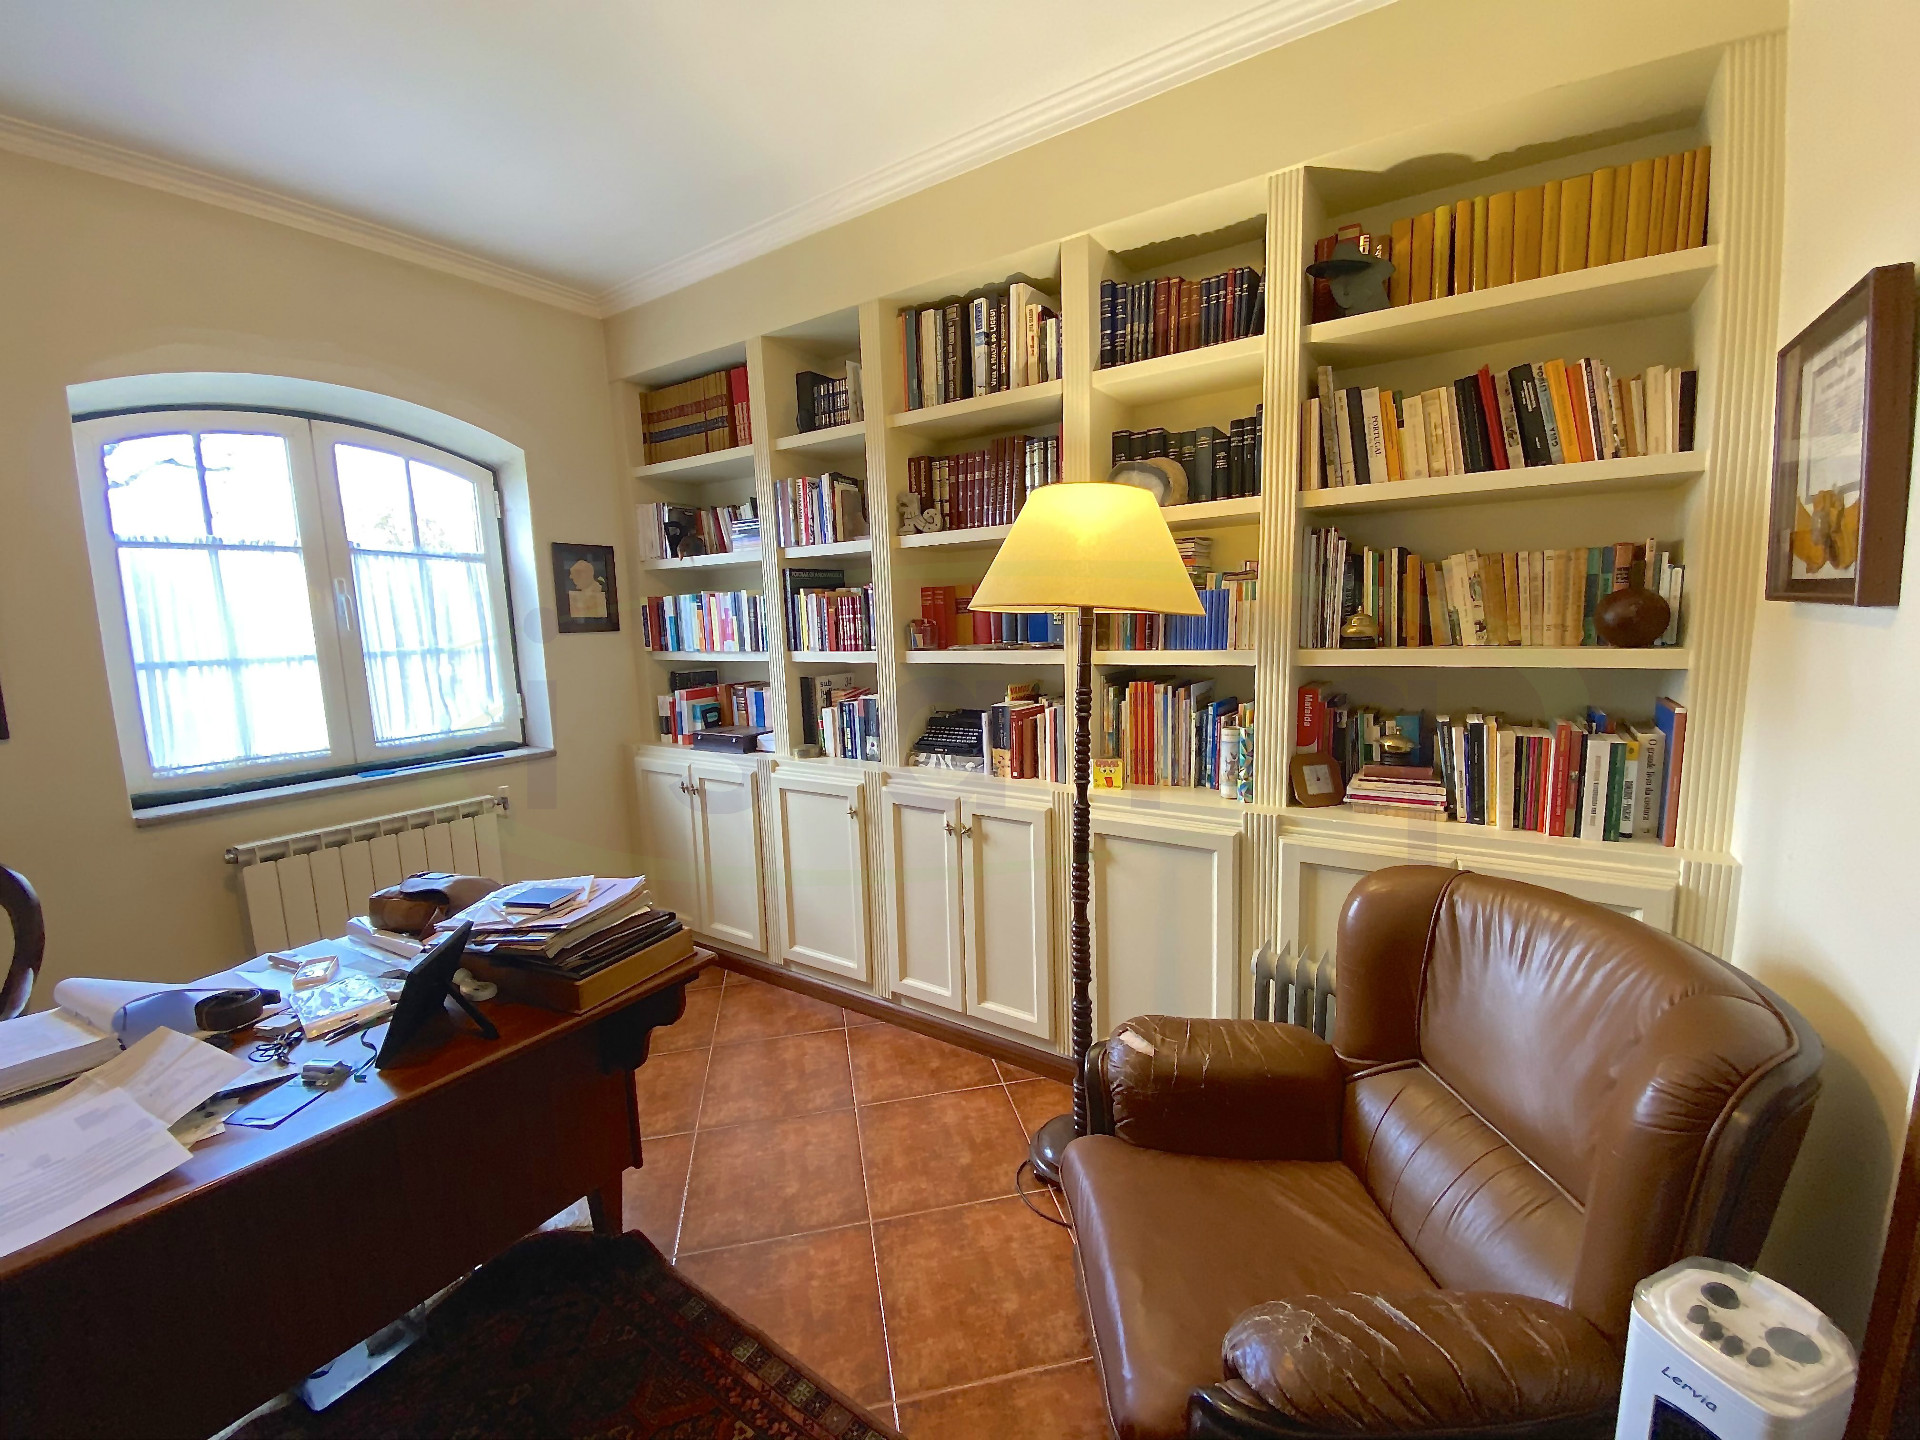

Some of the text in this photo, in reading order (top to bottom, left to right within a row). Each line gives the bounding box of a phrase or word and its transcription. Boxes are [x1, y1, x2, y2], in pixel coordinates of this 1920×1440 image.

[1371, 415, 1381, 456] PORTUGAL
[1549, 426, 1559, 447] GUIA
[820, 678, 832, 688] sub
[1304, 694, 1312, 727] Mafalda
[1643, 738, 1657, 821] O grande livro da costura
[1661, 1366, 1717, 1412] Lervia
